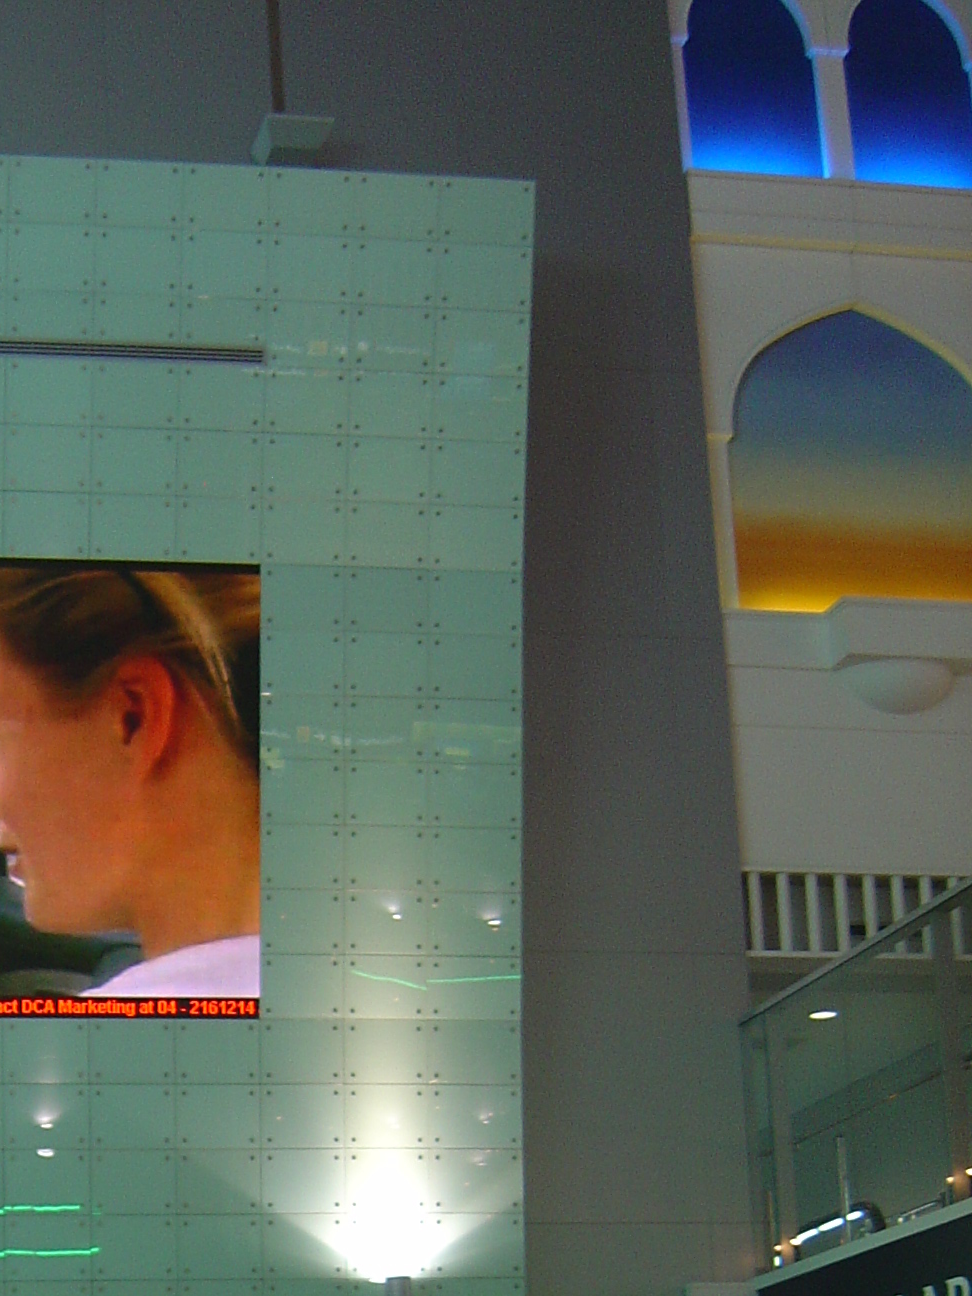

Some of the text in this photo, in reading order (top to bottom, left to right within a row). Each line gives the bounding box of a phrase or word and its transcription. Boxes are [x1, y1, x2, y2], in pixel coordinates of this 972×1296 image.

[21, 1000, 55, 1014] DCA
[57, 1000, 136, 1017] Marketing
[138, 1000, 155, 1014] at
[157, 1000, 177, 1015] 04
[189, 1000, 256, 1015] 2161214
